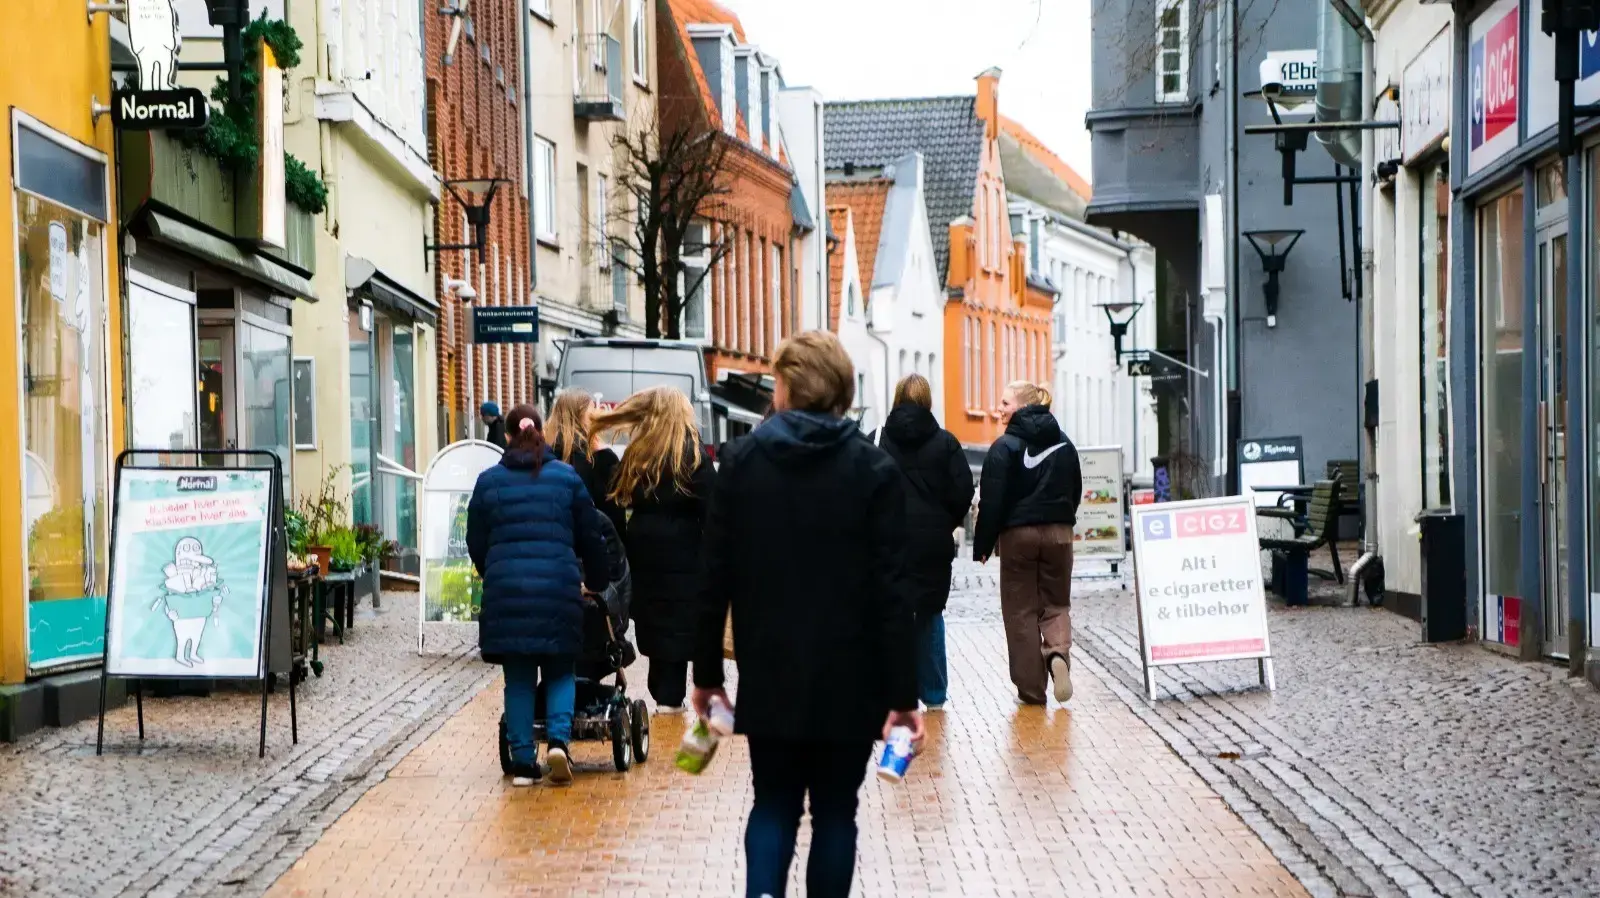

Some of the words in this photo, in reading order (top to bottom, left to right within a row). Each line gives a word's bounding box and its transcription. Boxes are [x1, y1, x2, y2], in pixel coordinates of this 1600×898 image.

[1474, 63, 1482, 125] e
[1488, 36, 1515, 114] CIGZ
[121, 94, 195, 120] Normal
[179, 477, 214, 490] Normal
[200, 510, 224, 520] hver
[1149, 519, 1164, 535] e
[1183, 513, 1240, 533] CIGZ
[1181, 556, 1207, 571] Alt
[1211, 555, 1217, 569] i
[1149, 586, 1159, 597] e
[1163, 578, 1254, 599] cigaretter
[1157, 606, 1170, 620] &
[1175, 601, 1250, 619] tilbehør
